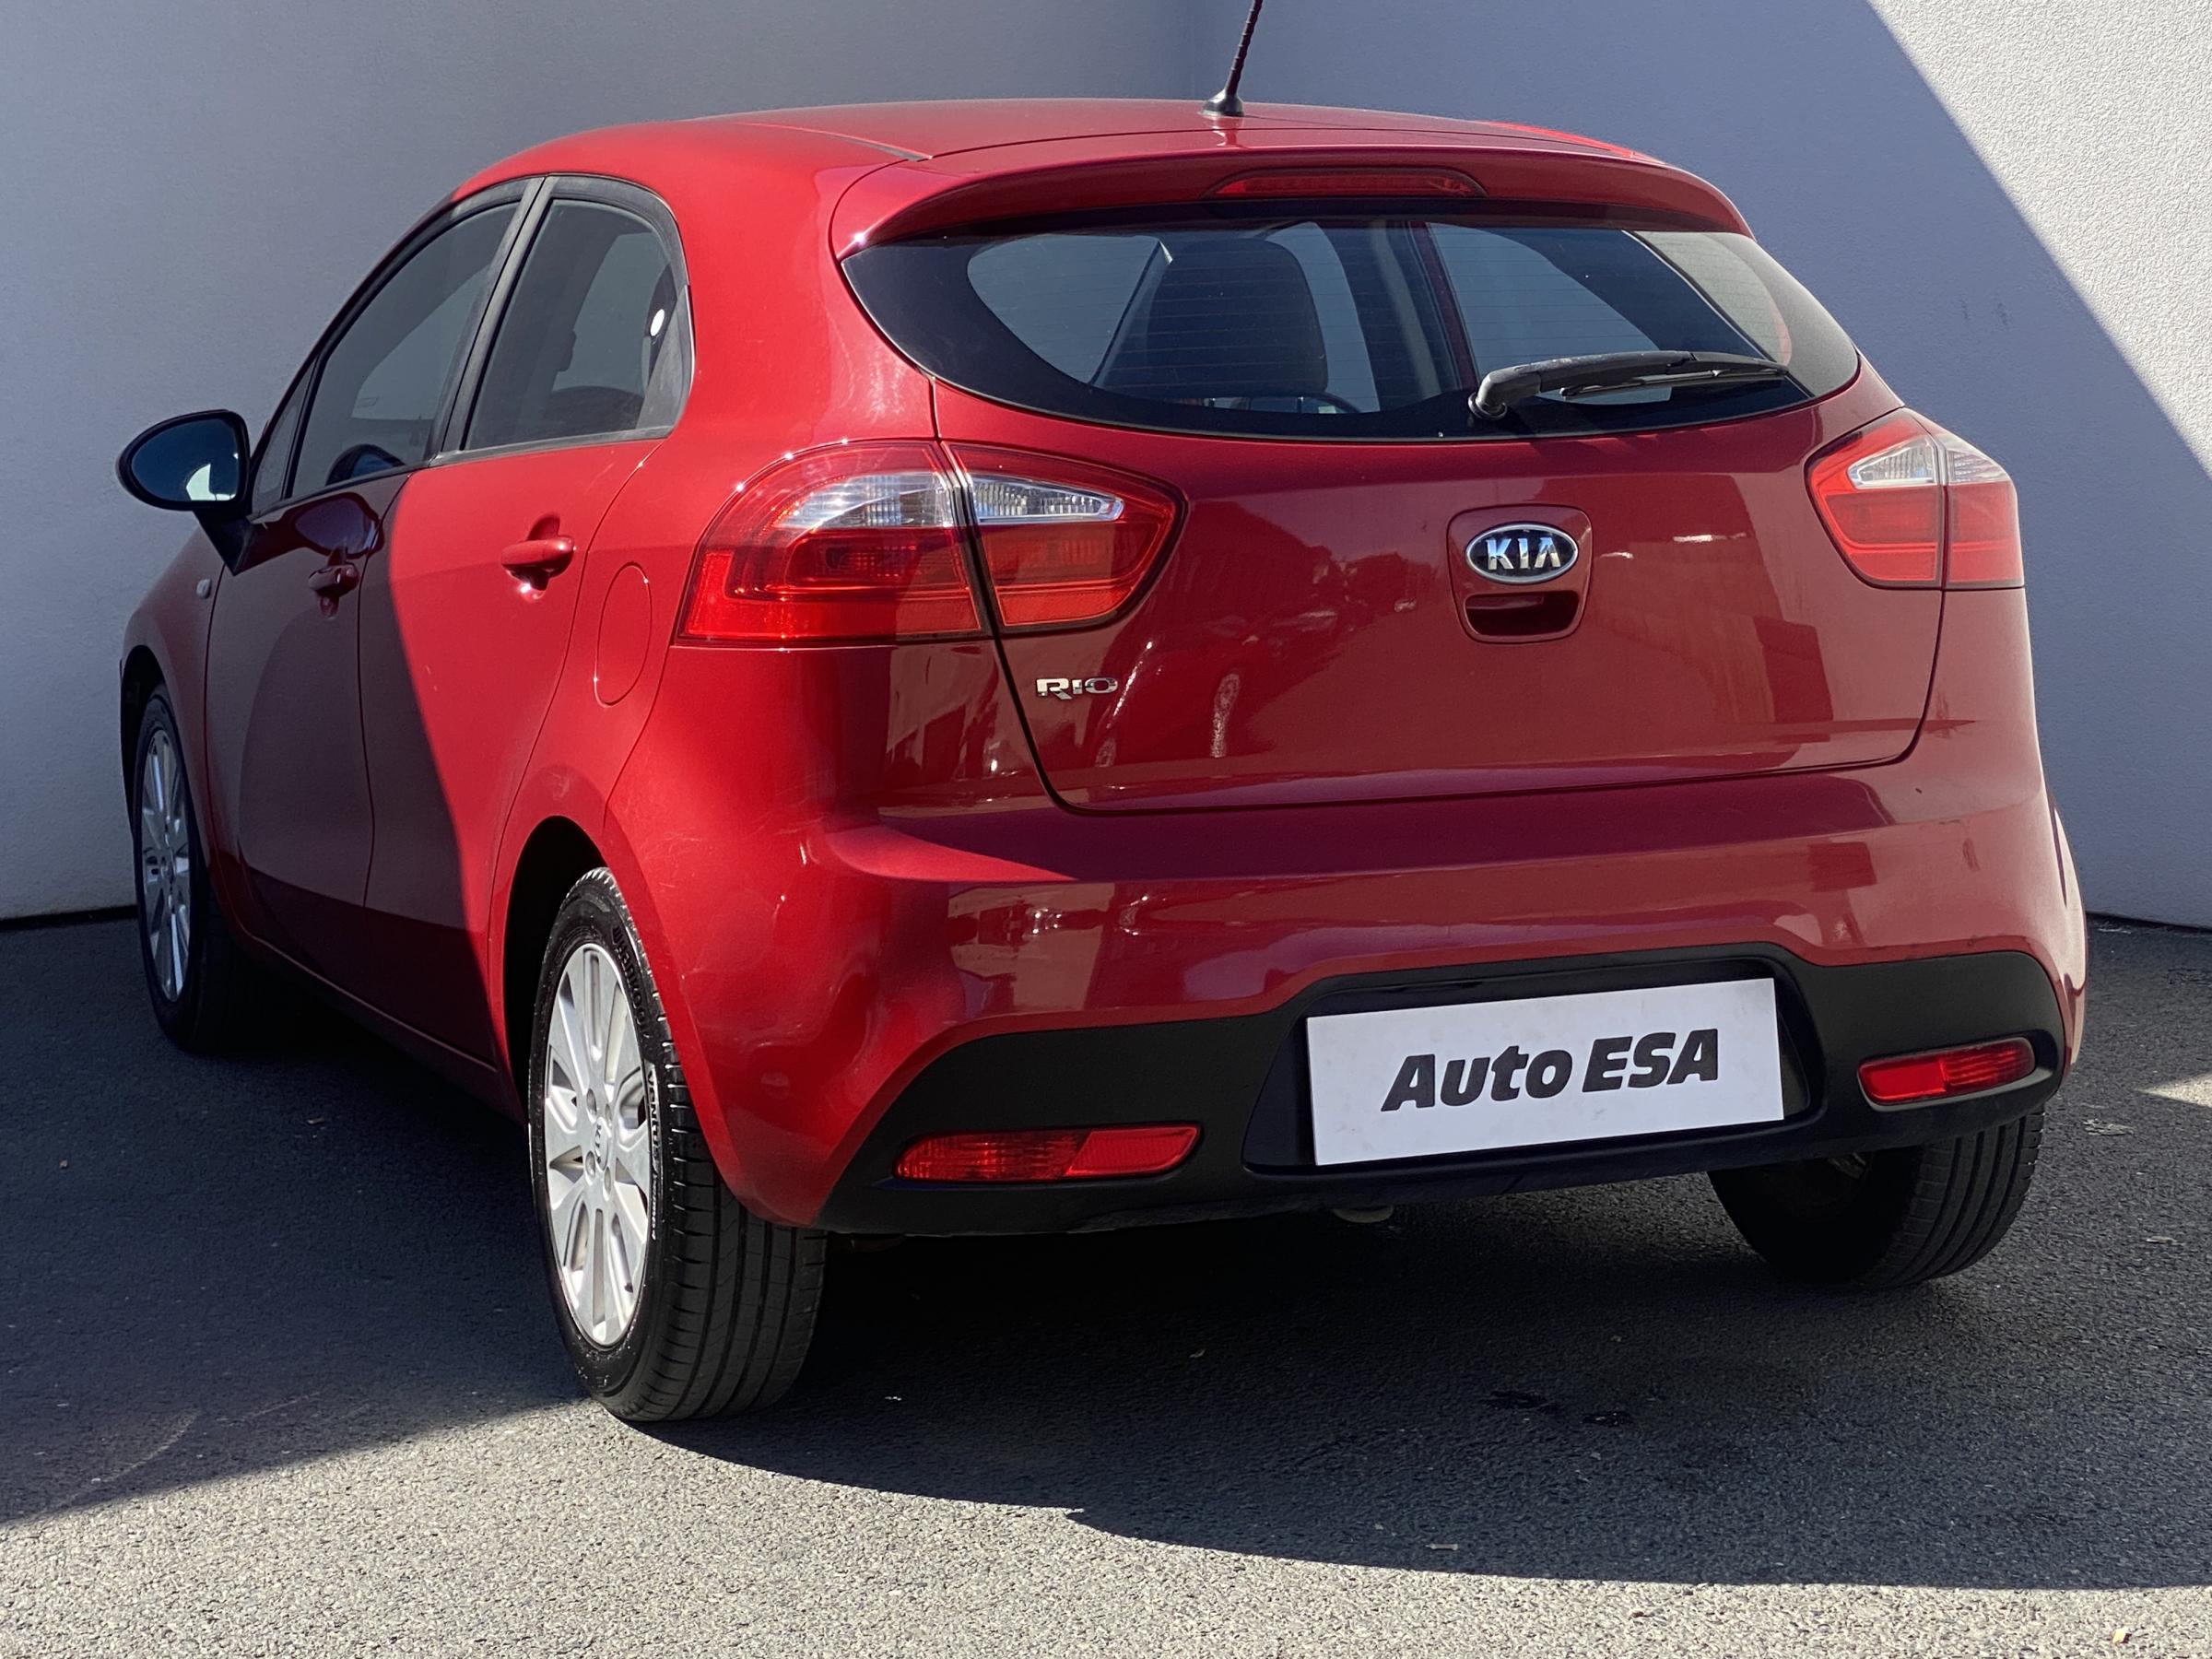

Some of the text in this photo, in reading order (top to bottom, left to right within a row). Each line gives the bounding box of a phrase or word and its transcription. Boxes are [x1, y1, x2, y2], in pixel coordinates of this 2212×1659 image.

[1485, 536, 1561, 570] KIA
[1036, 677, 1119, 700] RIO
[1380, 1028, 1719, 1112] Auto ESA
